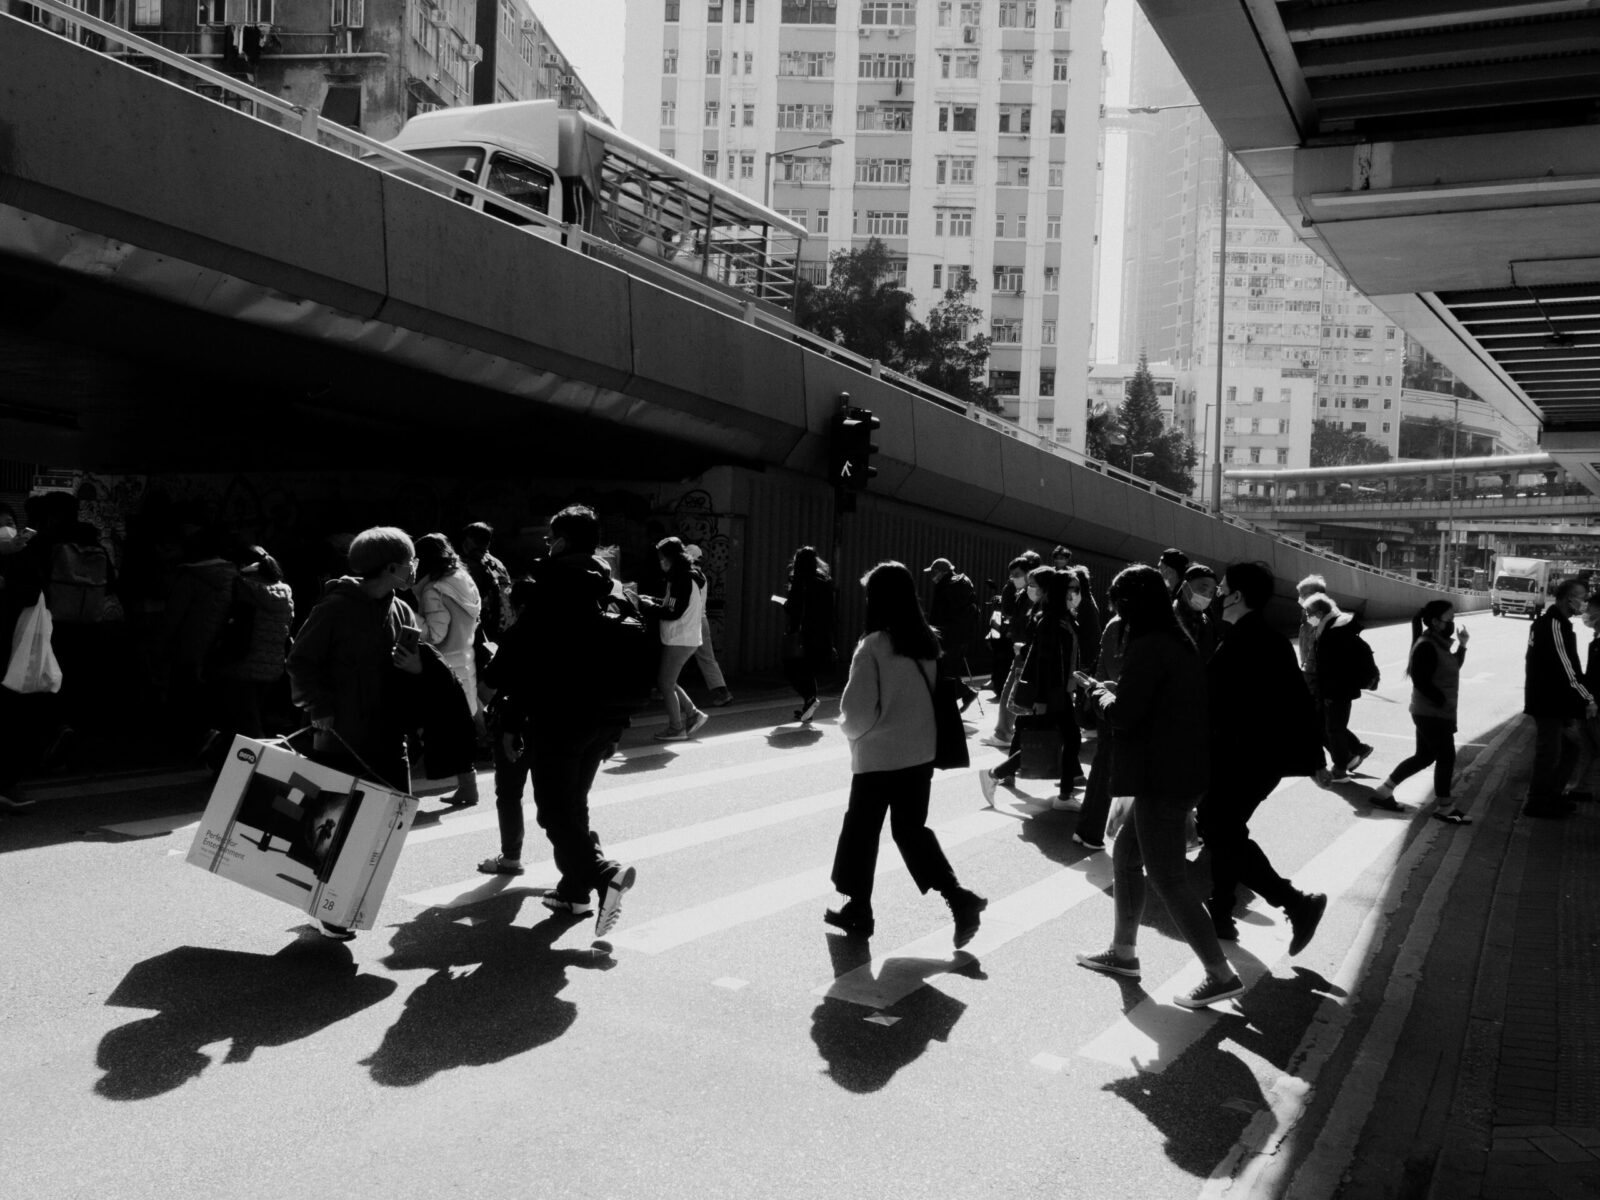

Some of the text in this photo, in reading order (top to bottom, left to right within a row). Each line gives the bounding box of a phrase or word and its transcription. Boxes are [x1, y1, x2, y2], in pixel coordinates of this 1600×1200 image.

[205, 829, 227, 843] Perfe
[203, 837, 245, 860] Enternment
[322, 898, 335, 911] 28
